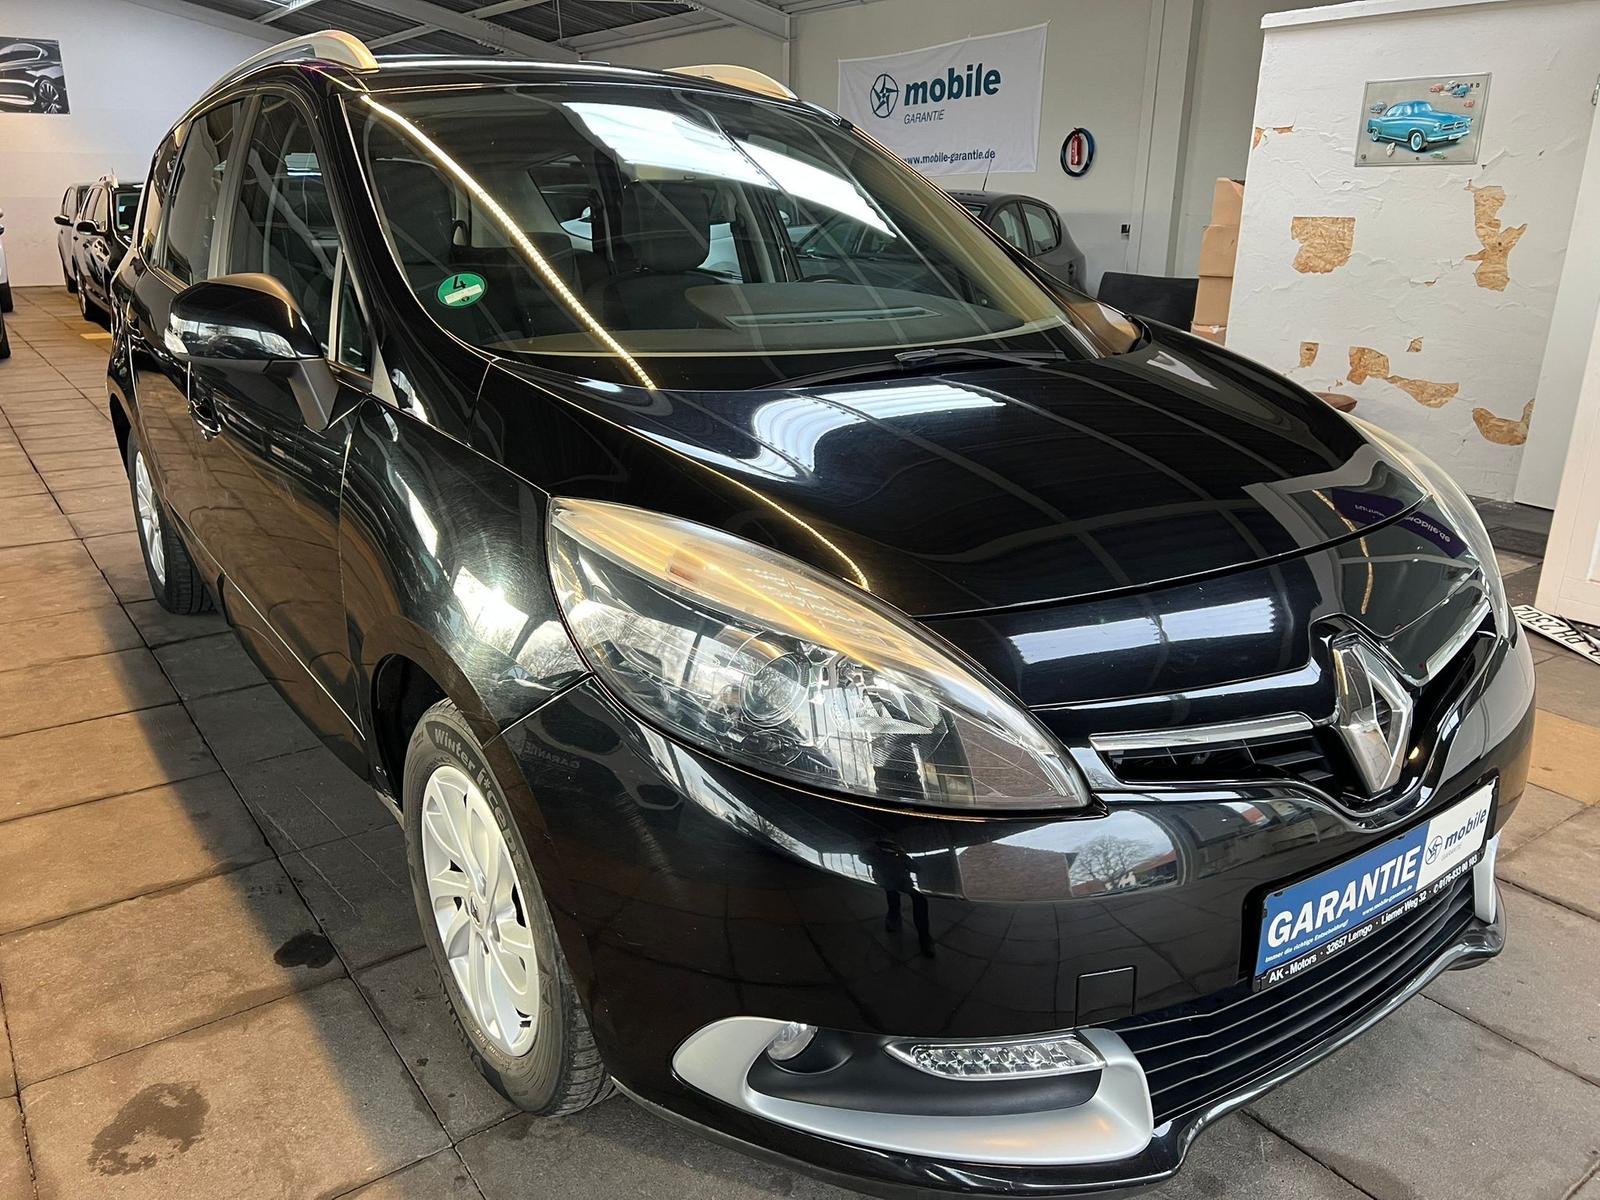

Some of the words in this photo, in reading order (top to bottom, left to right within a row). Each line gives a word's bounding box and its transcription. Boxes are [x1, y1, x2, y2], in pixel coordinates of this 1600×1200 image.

[904, 63, 1001, 106] mobile
[903, 109, 945, 125] GARANTIE
[453, 275, 467, 290] 4
[434, 728, 476, 770] Winter
[1444, 809, 1487, 850] mobile
[1267, 845, 1421, 948] GARANTIE
[1268, 968, 1284, 984] AK
[1289, 954, 1317, 975] Motors
[1326, 935, 1348, 955] 32657
[1347, 923, 1373, 943] Lemgo
[1381, 905, 1405, 925] Liemer
[1404, 897, 1419, 912] Weg
